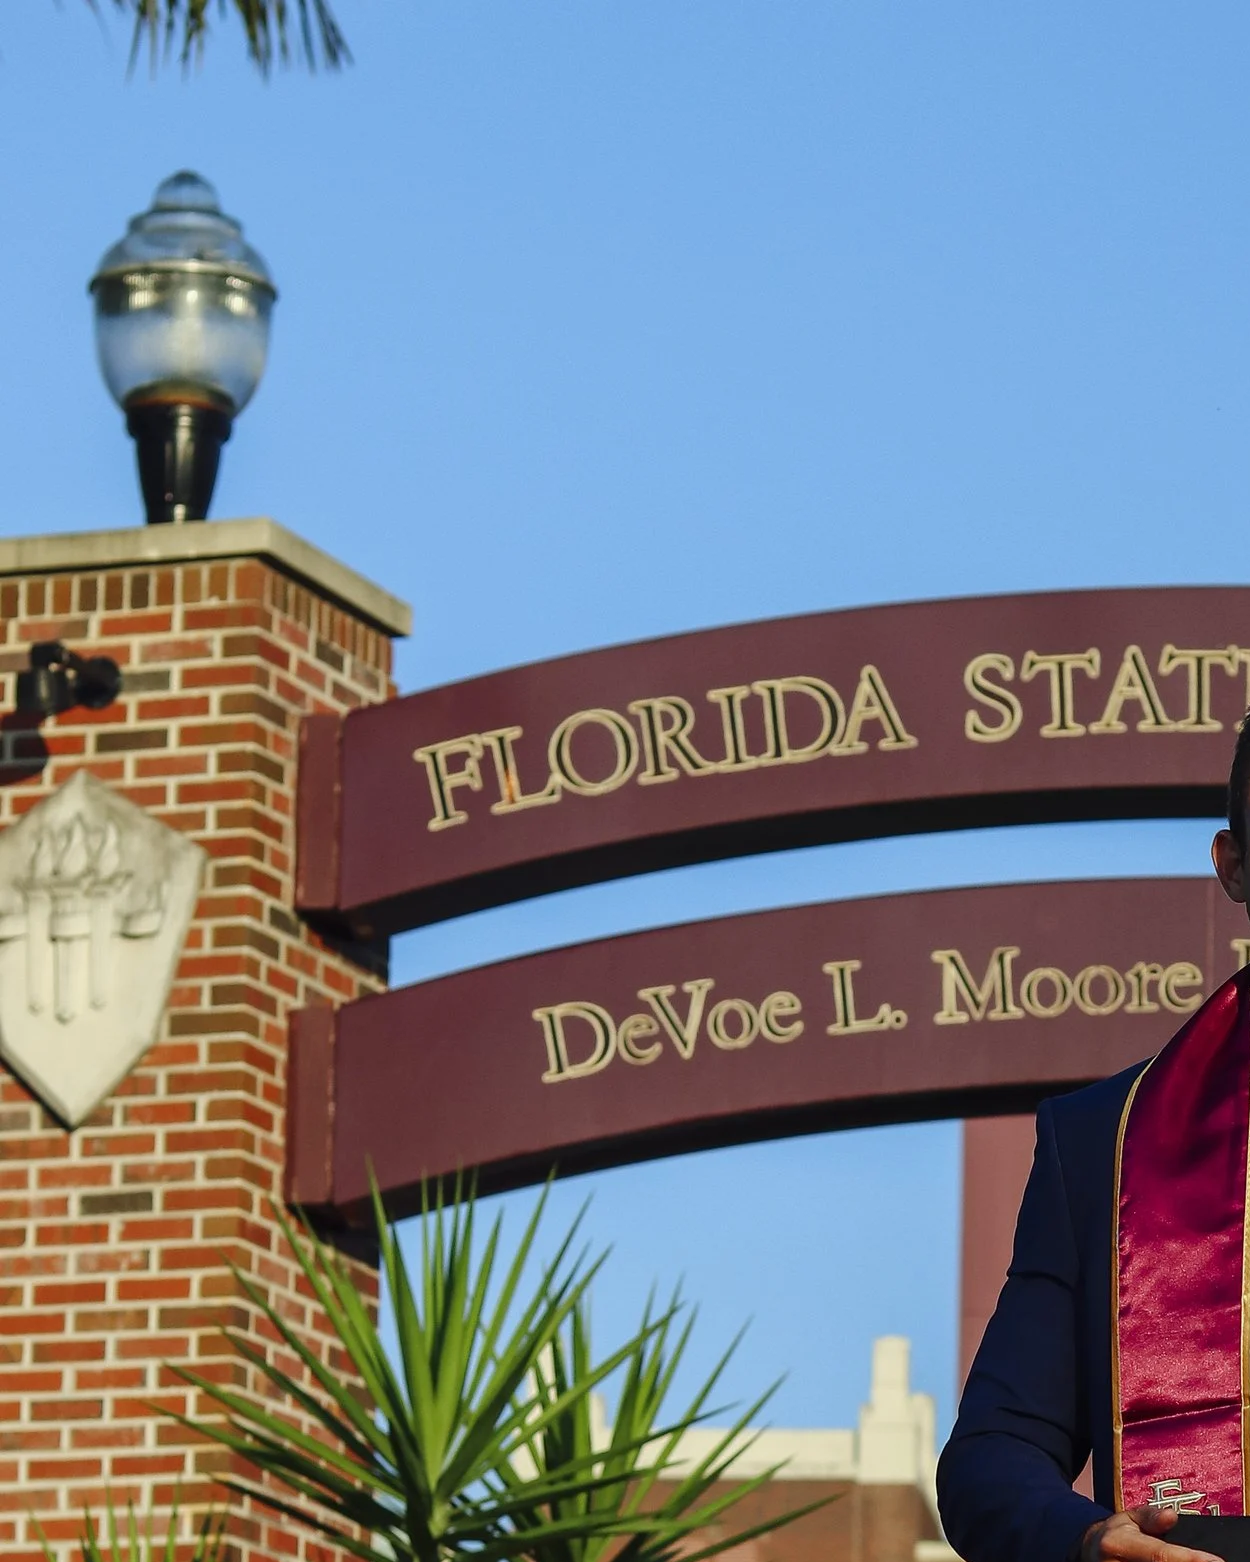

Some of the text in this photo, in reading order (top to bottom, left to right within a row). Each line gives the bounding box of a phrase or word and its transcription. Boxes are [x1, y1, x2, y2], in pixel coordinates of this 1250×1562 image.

[413, 664, 919, 832] FLORIDA
[532, 978, 805, 1084] DeVoe
[822, 959, 908, 1036] L.
[930, 945, 1204, 1026] Moore
